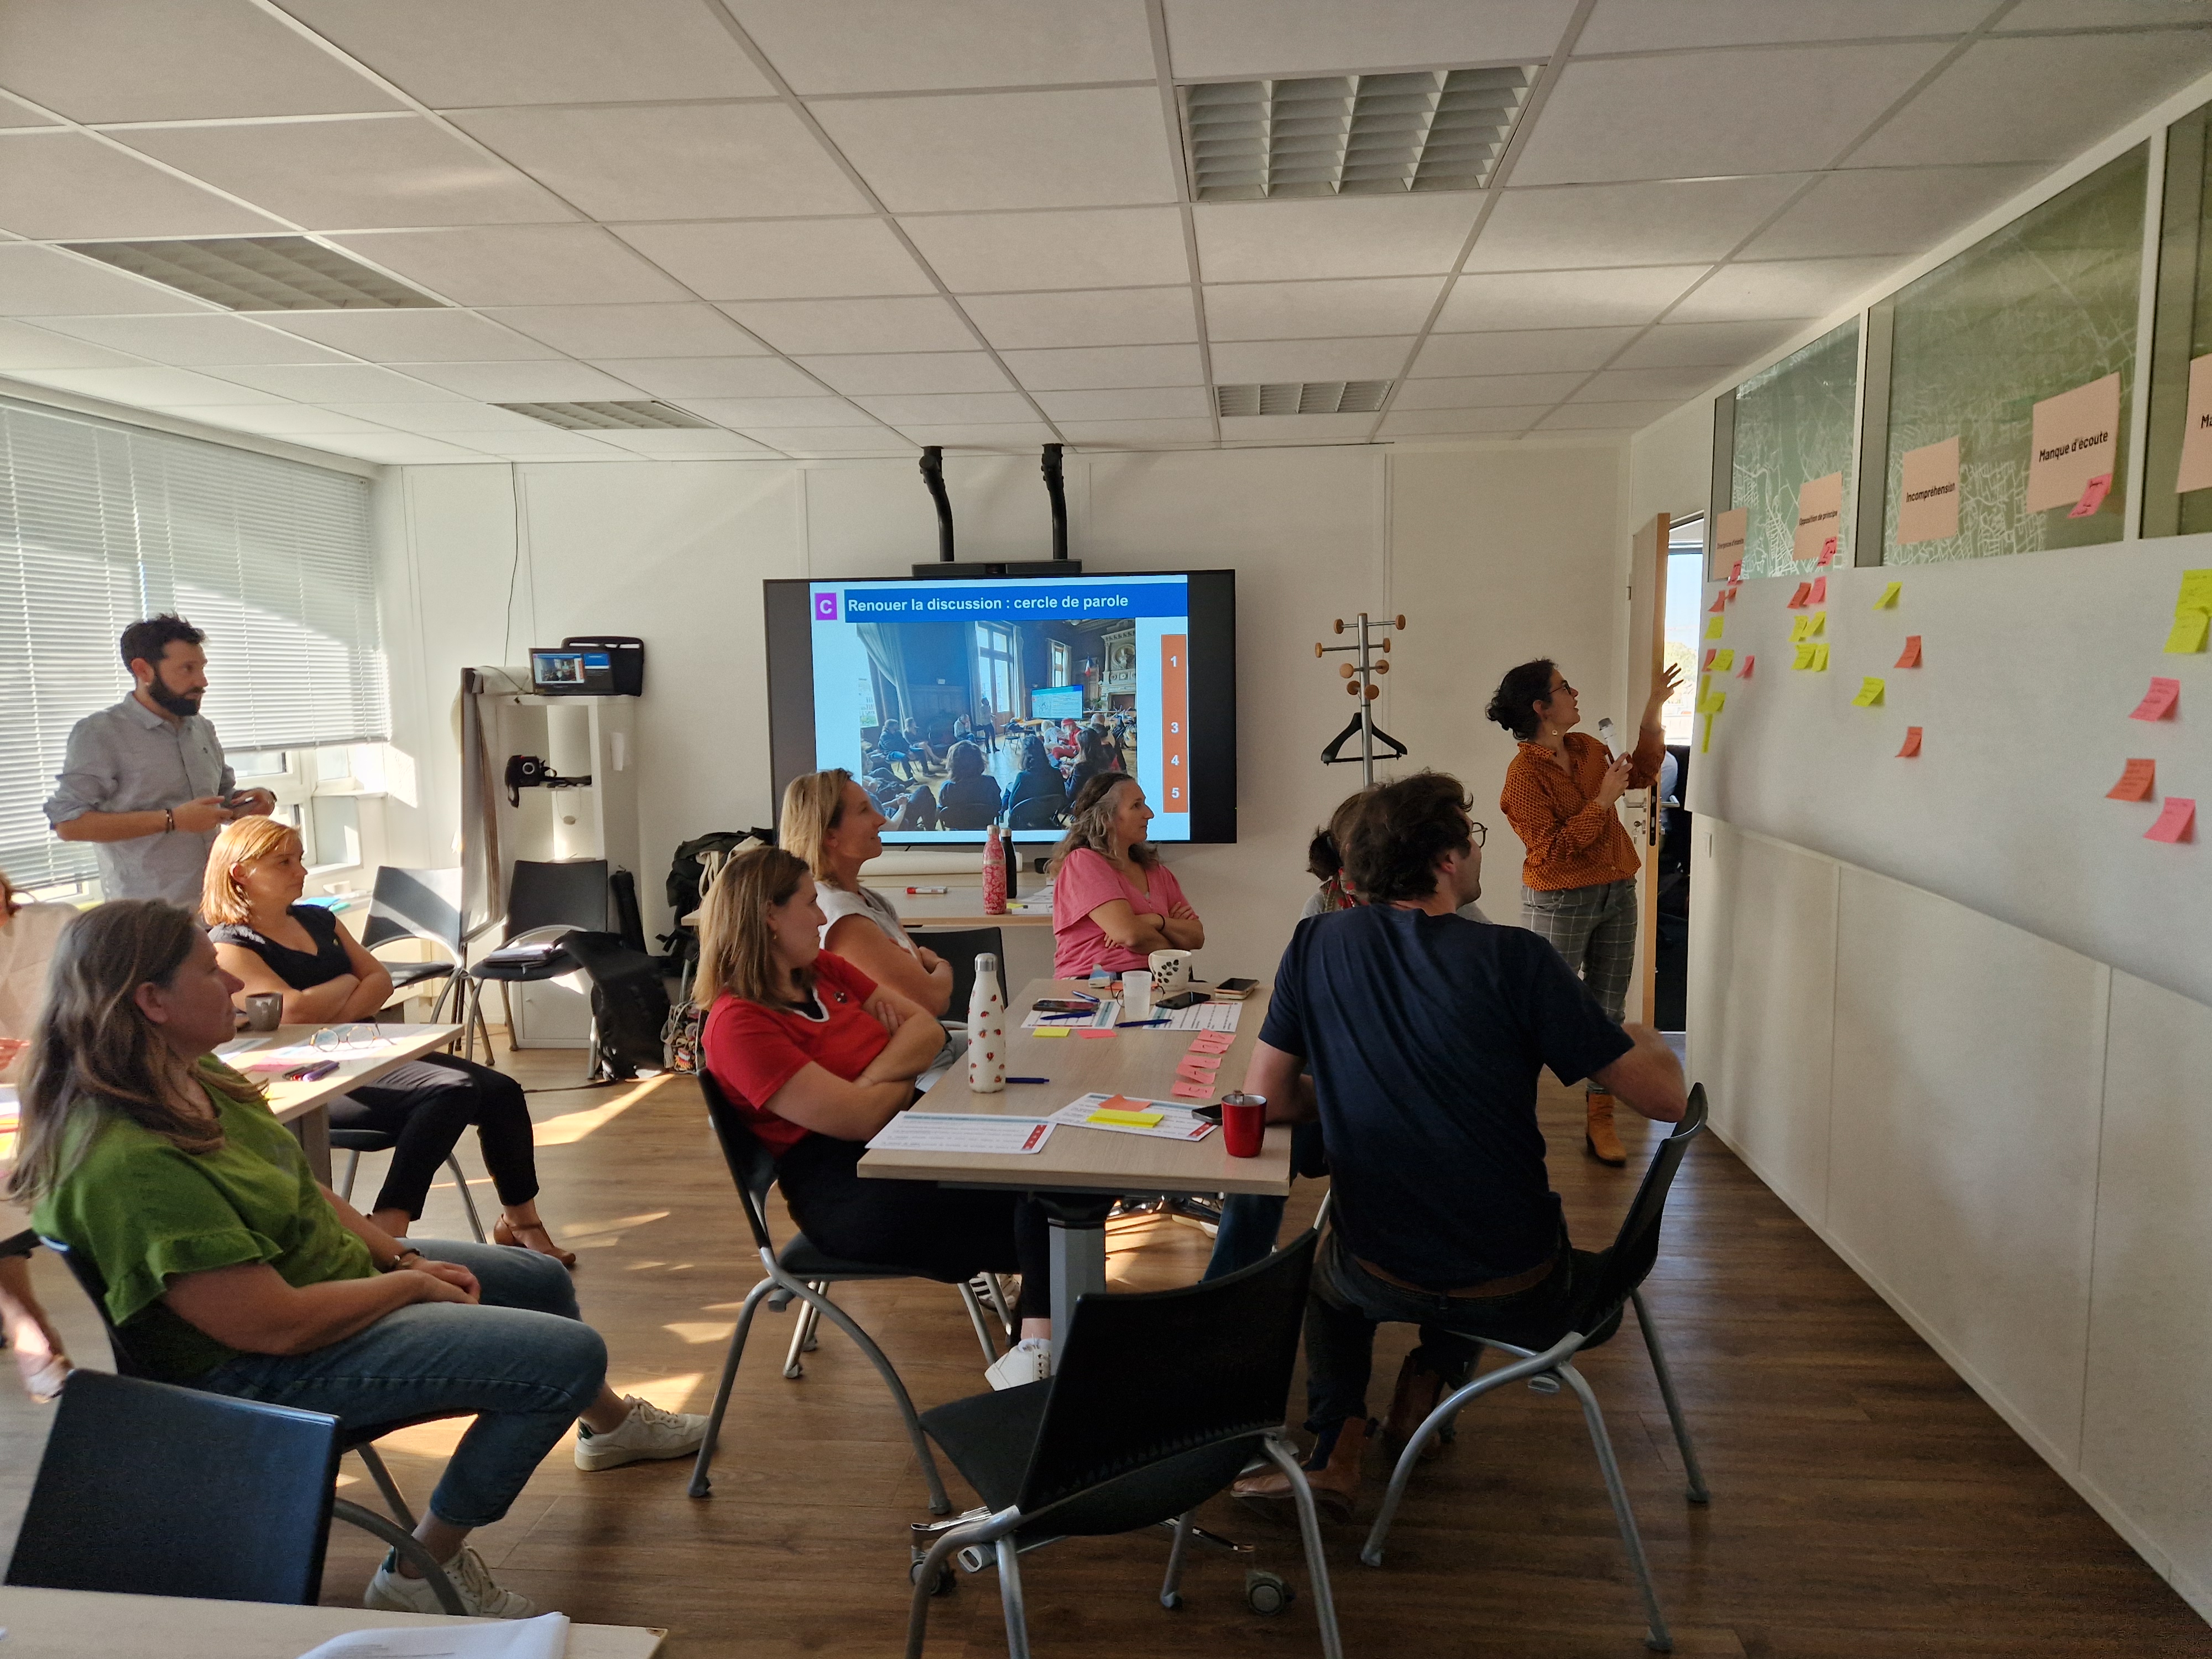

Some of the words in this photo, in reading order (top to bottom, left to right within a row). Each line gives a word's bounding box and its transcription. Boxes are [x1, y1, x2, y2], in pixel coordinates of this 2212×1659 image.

[2038, 444, 2069, 462] Manque
[2071, 431, 2108, 452] d'écoute
[1906, 481, 1955, 503] Incompréhension
[820, 599, 832, 614] C
[848, 599, 907, 612] Renouer
[912, 598, 924, 611] la
[927, 597, 1001, 610] discussion
[1014, 596, 1057, 609] cercle
[1062, 596, 1079, 608] de
[1083, 594, 1128, 610] parole
[1170, 655, 1177, 667] 1
[1171, 722, 1178, 733] 3
[1171, 755, 1180, 766] 4
[1171, 787, 1179, 798] 5
